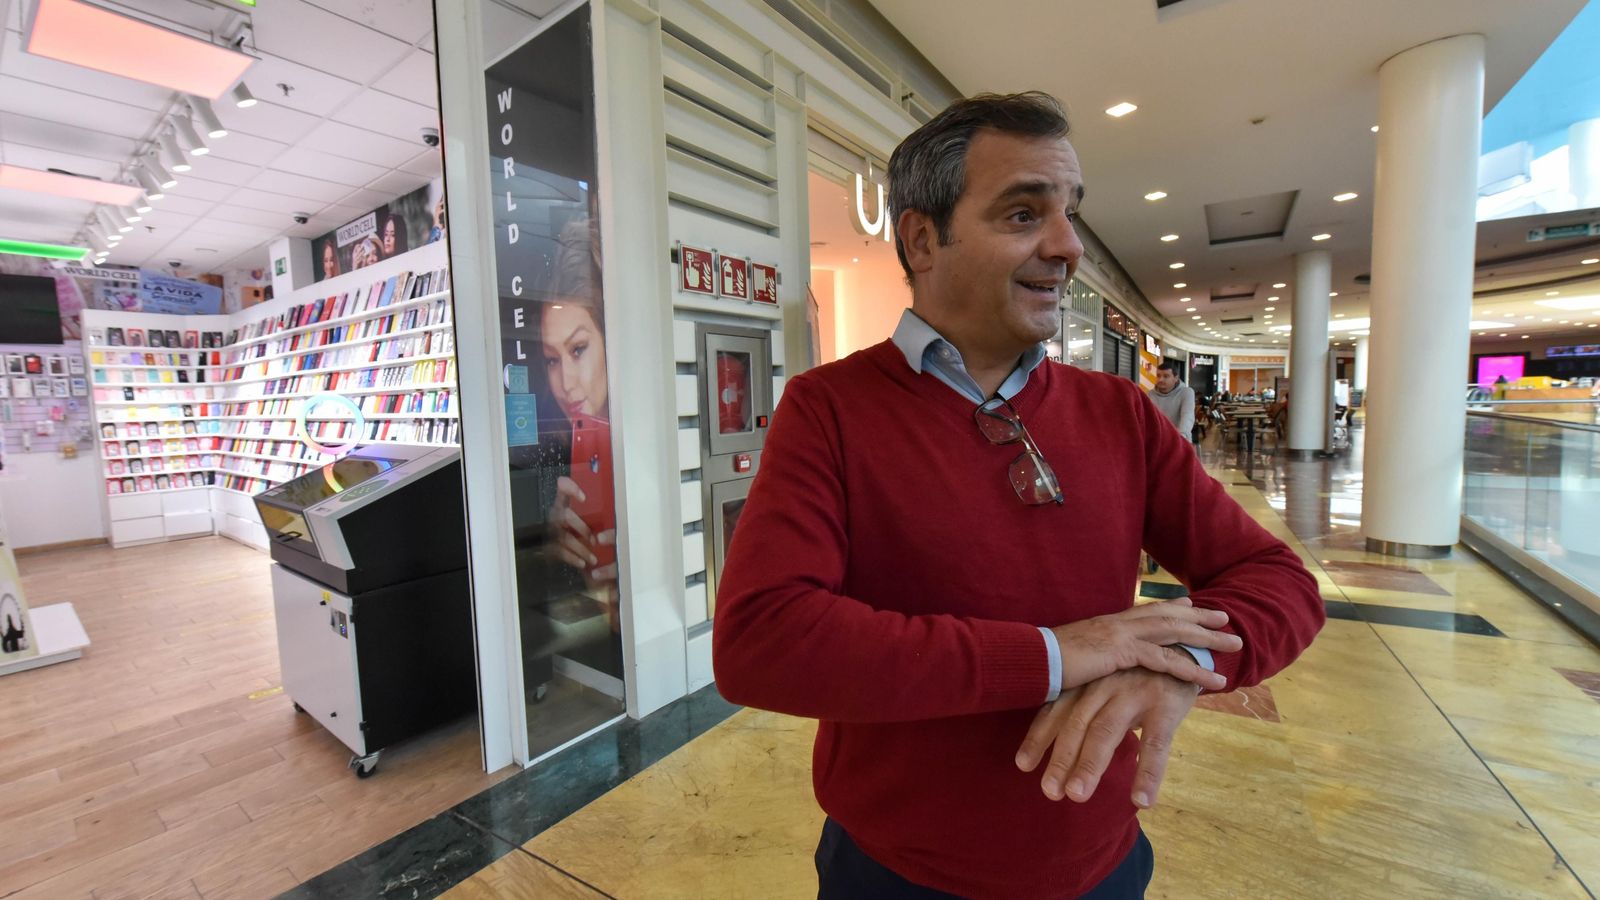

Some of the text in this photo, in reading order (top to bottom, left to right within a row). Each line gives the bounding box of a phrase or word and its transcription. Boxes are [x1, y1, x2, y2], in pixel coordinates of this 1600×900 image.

[337, 216, 375, 243] WORLD CELL
[497, 87, 520, 245] WORLD
[511, 275, 527, 361] CEL
[64, 266, 138, 281] WORLD CELL
